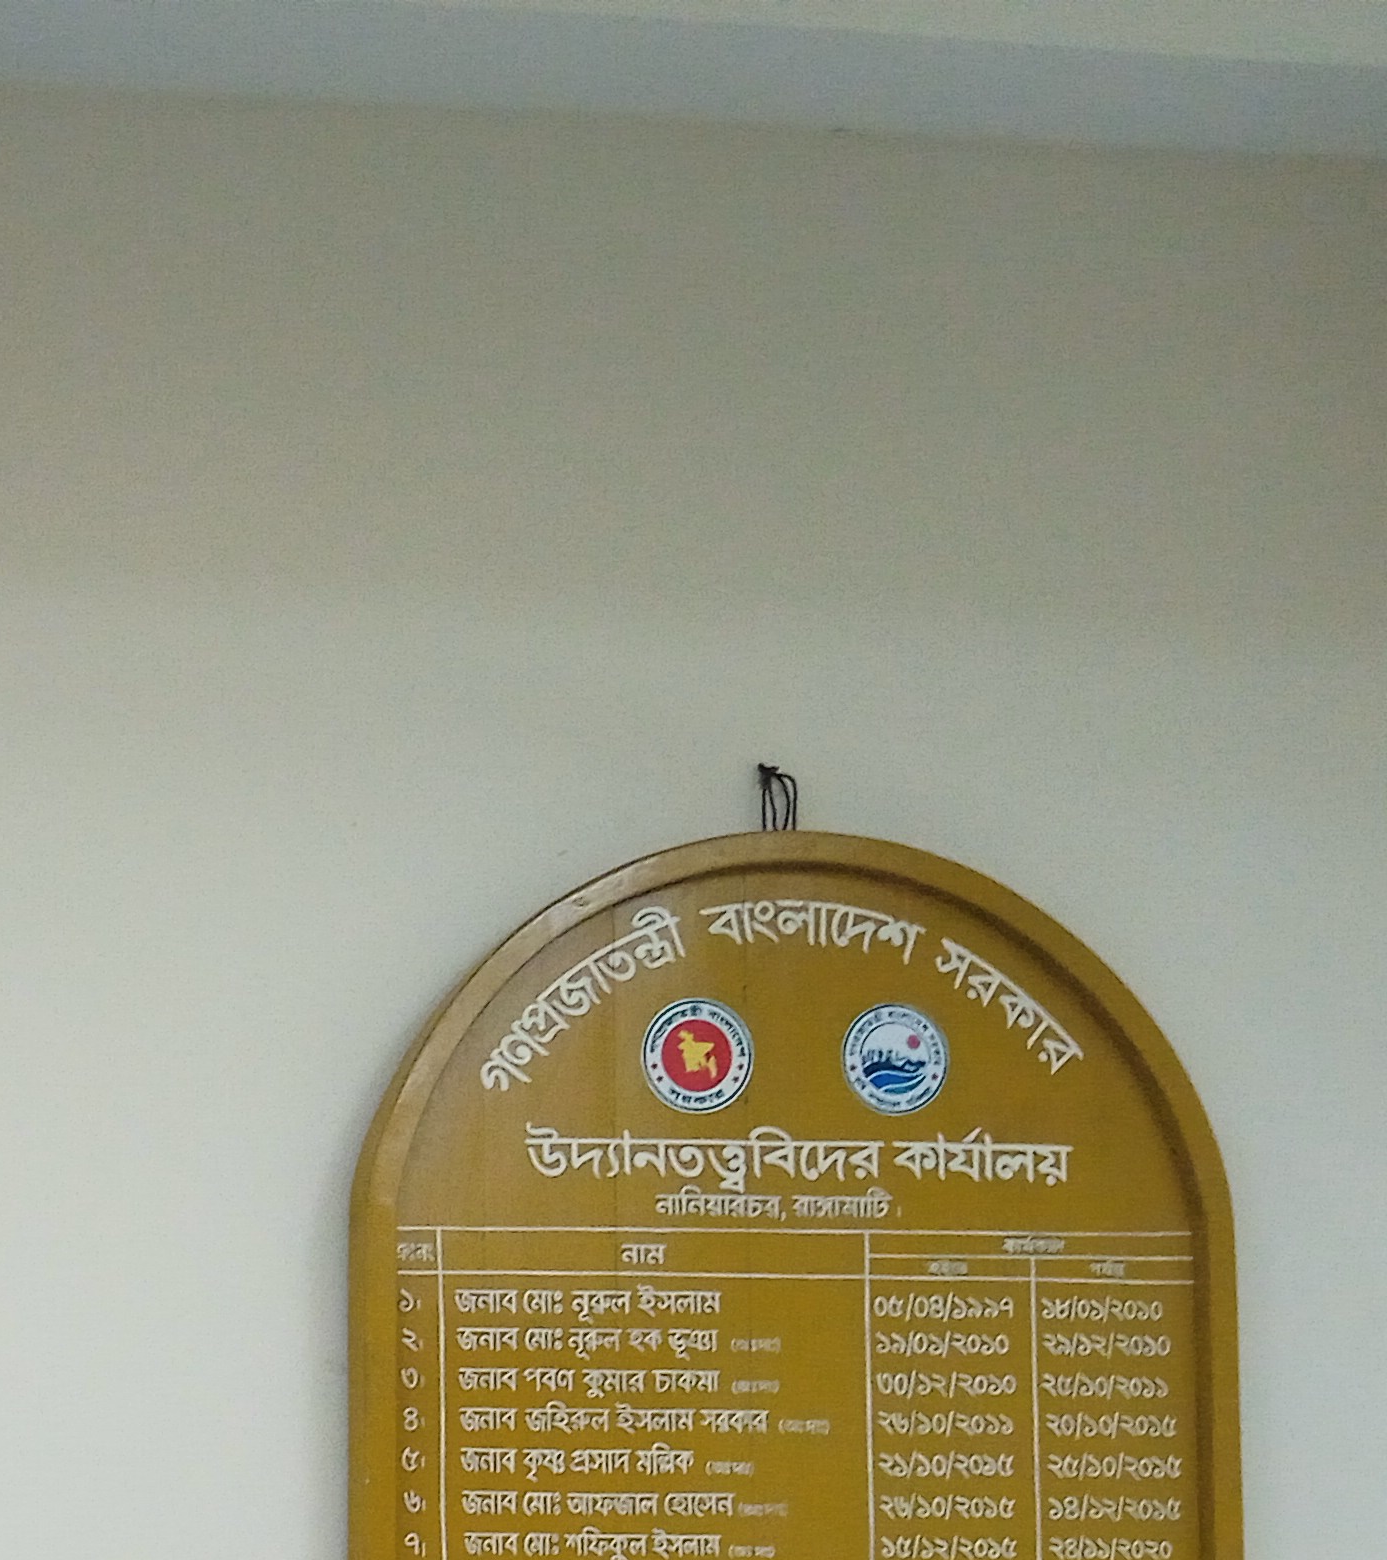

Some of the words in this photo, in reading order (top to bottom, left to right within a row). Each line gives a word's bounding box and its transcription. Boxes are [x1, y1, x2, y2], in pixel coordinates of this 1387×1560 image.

[481, 905, 686, 1094] গণপ্রজাতন্ত্রী
[699, 899, 927, 964] বাংলাদেশ
[934, 938, 1084, 1074] সরকার
[892, 1126, 1073, 1187] কার্যালয়
[620, 1242, 667, 1265] নাম
[454, 1289, 519, 1314] জনাব
[523, 1289, 563, 1314] মোঃ
[637, 1284, 722, 1317] ইসলাম
[456, 1327, 520, 1351] জনাব
[525, 1327, 563, 1351] মোঃ
[626, 1328, 662, 1352] হক
[458, 1368, 520, 1391] জনাব
[582, 1369, 646, 1398] কুমার
[651, 1370, 720, 1393] চাকমা
[459, 1407, 518, 1432] জনাব
[525, 1400, 610, 1434] জহিরুল
[615, 1402, 697, 1434] ইসলাম
[700, 1409, 770, 1434] সরকার
[461, 1447, 518, 1474] জনাব
[570, 1449, 632, 1474] প্রসাদ
[462, 1490, 518, 1515] জনাব
[523, 1491, 562, 1516] মোঃ
[567, 1492, 659, 1516] আফজাল
[664, 1493, 735, 1517] হোসেন
[464, 1532, 520, 1555] জনাব
[524, 1533, 560, 1556] মোঃ
[651, 1528, 722, 1559] ইসলাম
